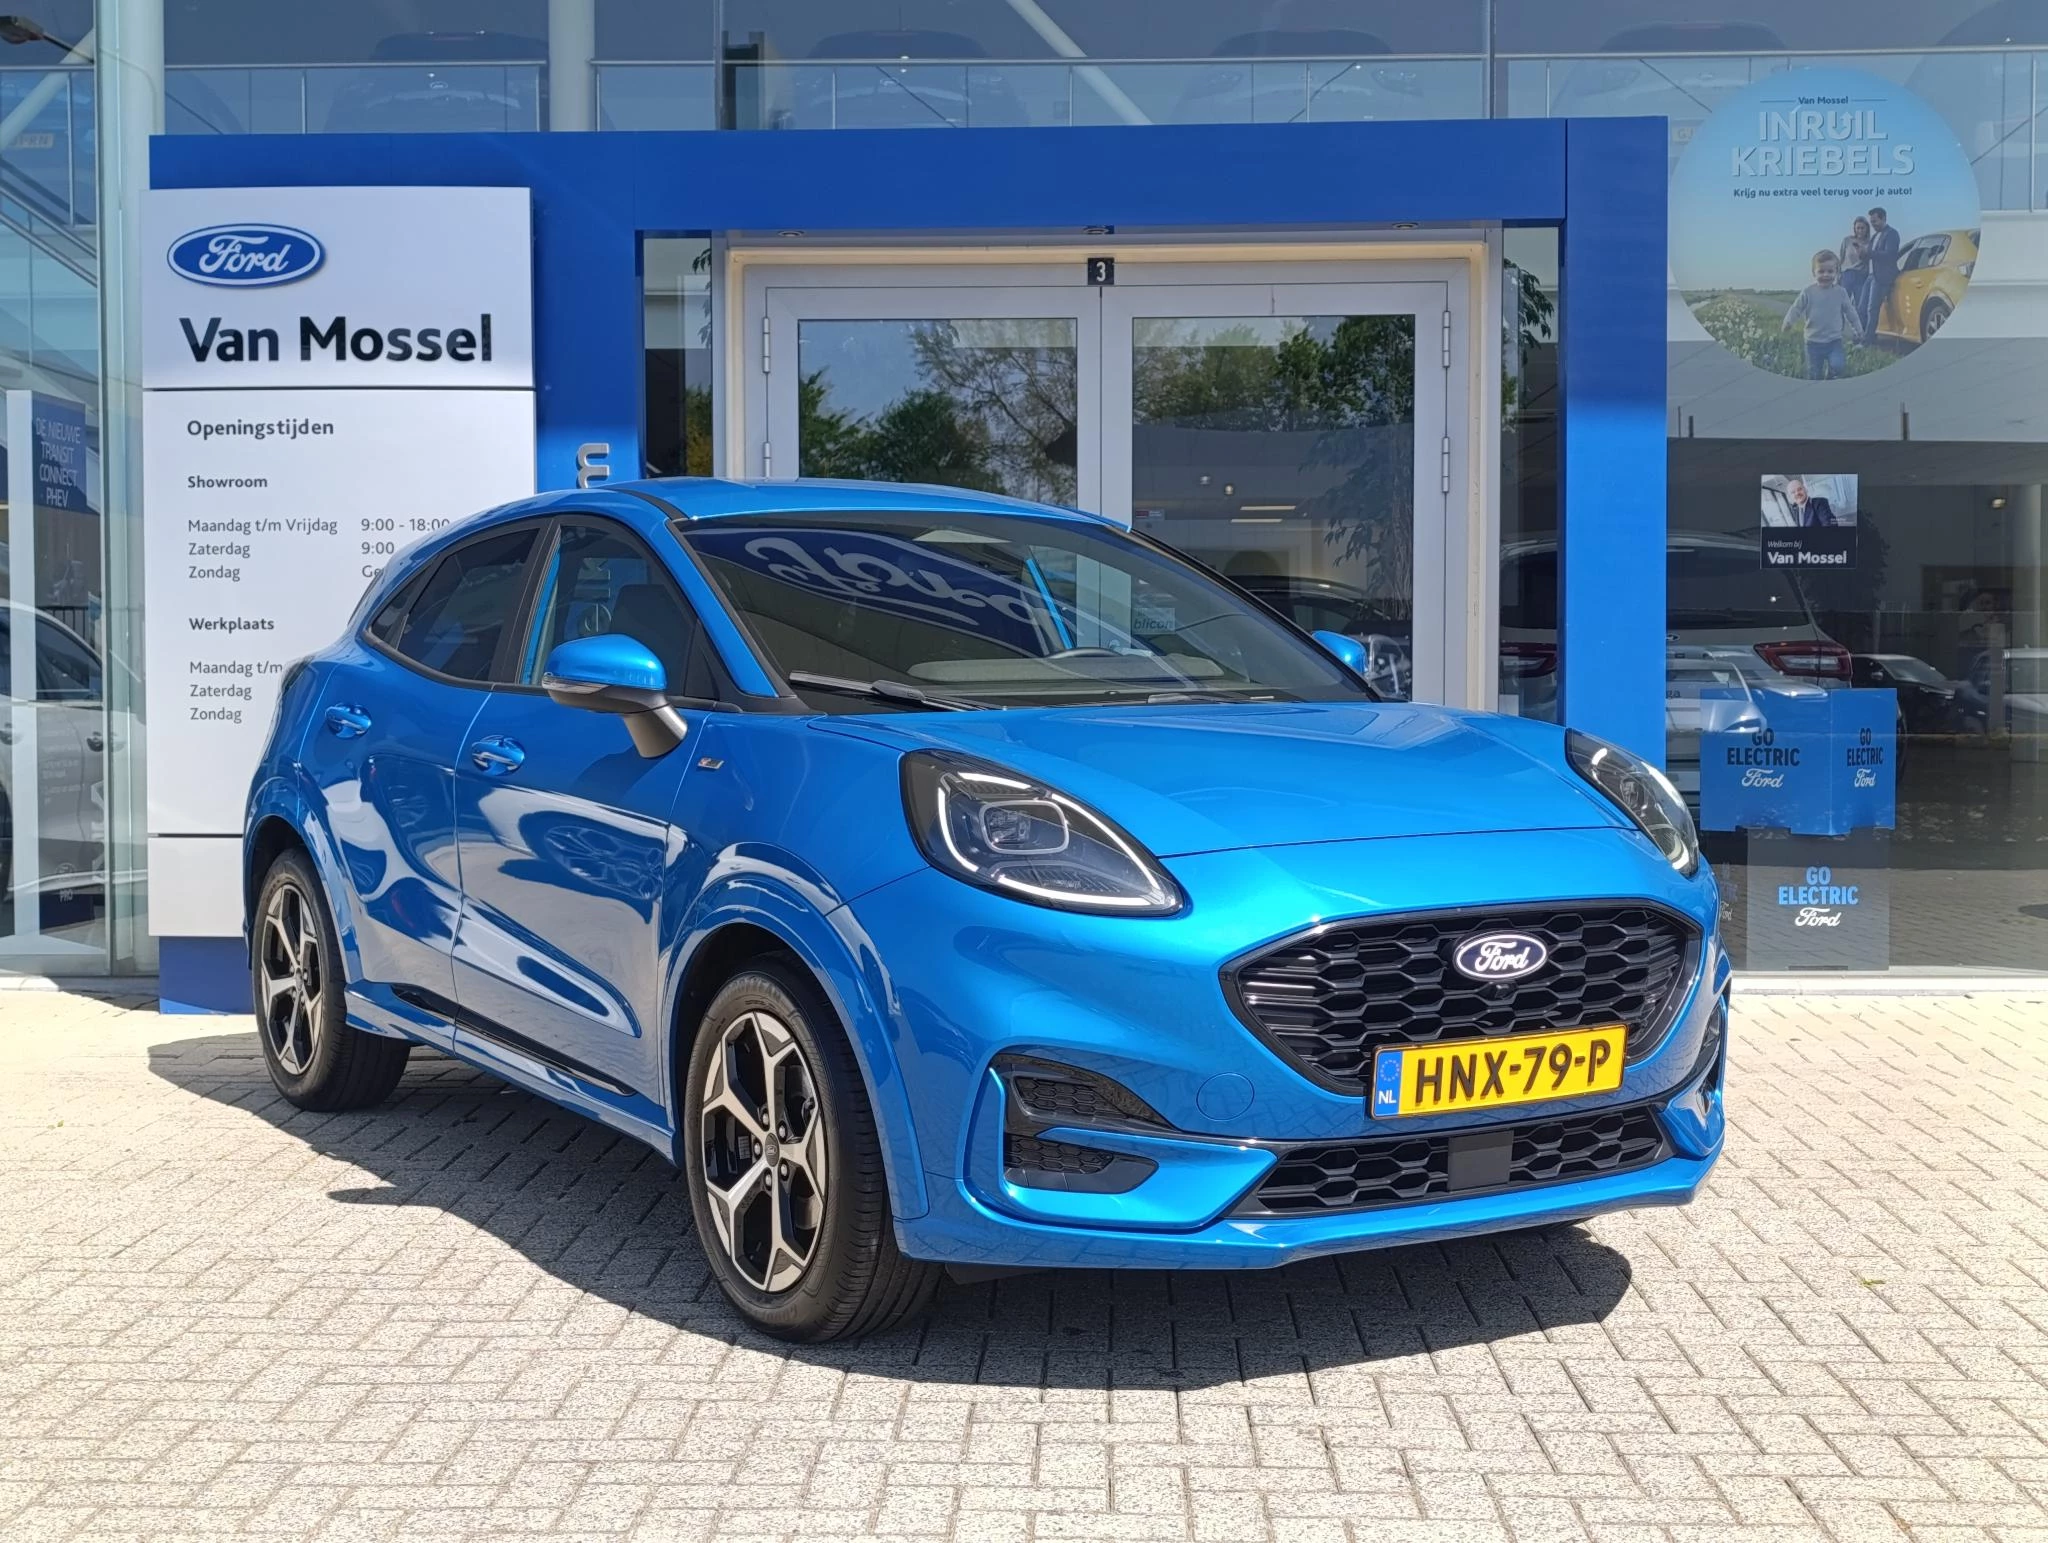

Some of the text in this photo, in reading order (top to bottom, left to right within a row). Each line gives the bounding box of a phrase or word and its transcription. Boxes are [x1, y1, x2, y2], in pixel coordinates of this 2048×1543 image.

[1798, 96, 1848, 105] Van Mossel
[1759, 110, 1888, 141] INRUIL
[1732, 145, 1915, 177] KRIEBELS
[1733, 187, 1912, 198] Krijg nu extra veel terug voor je auto!
[199, 235, 291, 273] Ford
[1096, 261, 1106, 282] 3
[179, 314, 492, 362] Van Mossel
[49, 419, 81, 444] NIEUWE
[187, 418, 334, 440] Openingstijden
[40, 441, 74, 464] TRANSIT
[39, 464, 78, 488] CONNECT
[188, 475, 268, 489] Showroom
[46, 488, 70, 508] PHEV
[188, 518, 338, 536] Maandag t/m Vrijdag
[361, 518, 395, 532] 9:00
[188, 541, 251, 559] Zaterdag
[361, 541, 395, 555] 9:00
[1767, 540, 1793, 549] Welkom
[1767, 551, 1847, 564] Van Mossel
[188, 565, 241, 583] Zondag
[189, 616, 275, 634] Werkplaats
[189, 660, 283, 678] Maandag t/m
[190, 684, 253, 701] Zaterdag
[190, 706, 243, 725] Zondag
[1752, 728, 1774, 746] GO
[1860, 728, 1872, 746] GO
[1727, 747, 1800, 766] ELECTRIC
[1847, 747, 1884, 767] ELECTRIC
[1741, 768, 1784, 788] Ford
[1854, 768, 1876, 788] Ford
[1806, 866, 1831, 885] GO
[1778, 886, 1858, 905] ELECTRIC
[1794, 907, 1842, 926] Ford
[1474, 941, 1531, 972] Ford
[1415, 1038, 1611, 1106] HNX-79-P
[1377, 1089, 1397, 1104] NL
